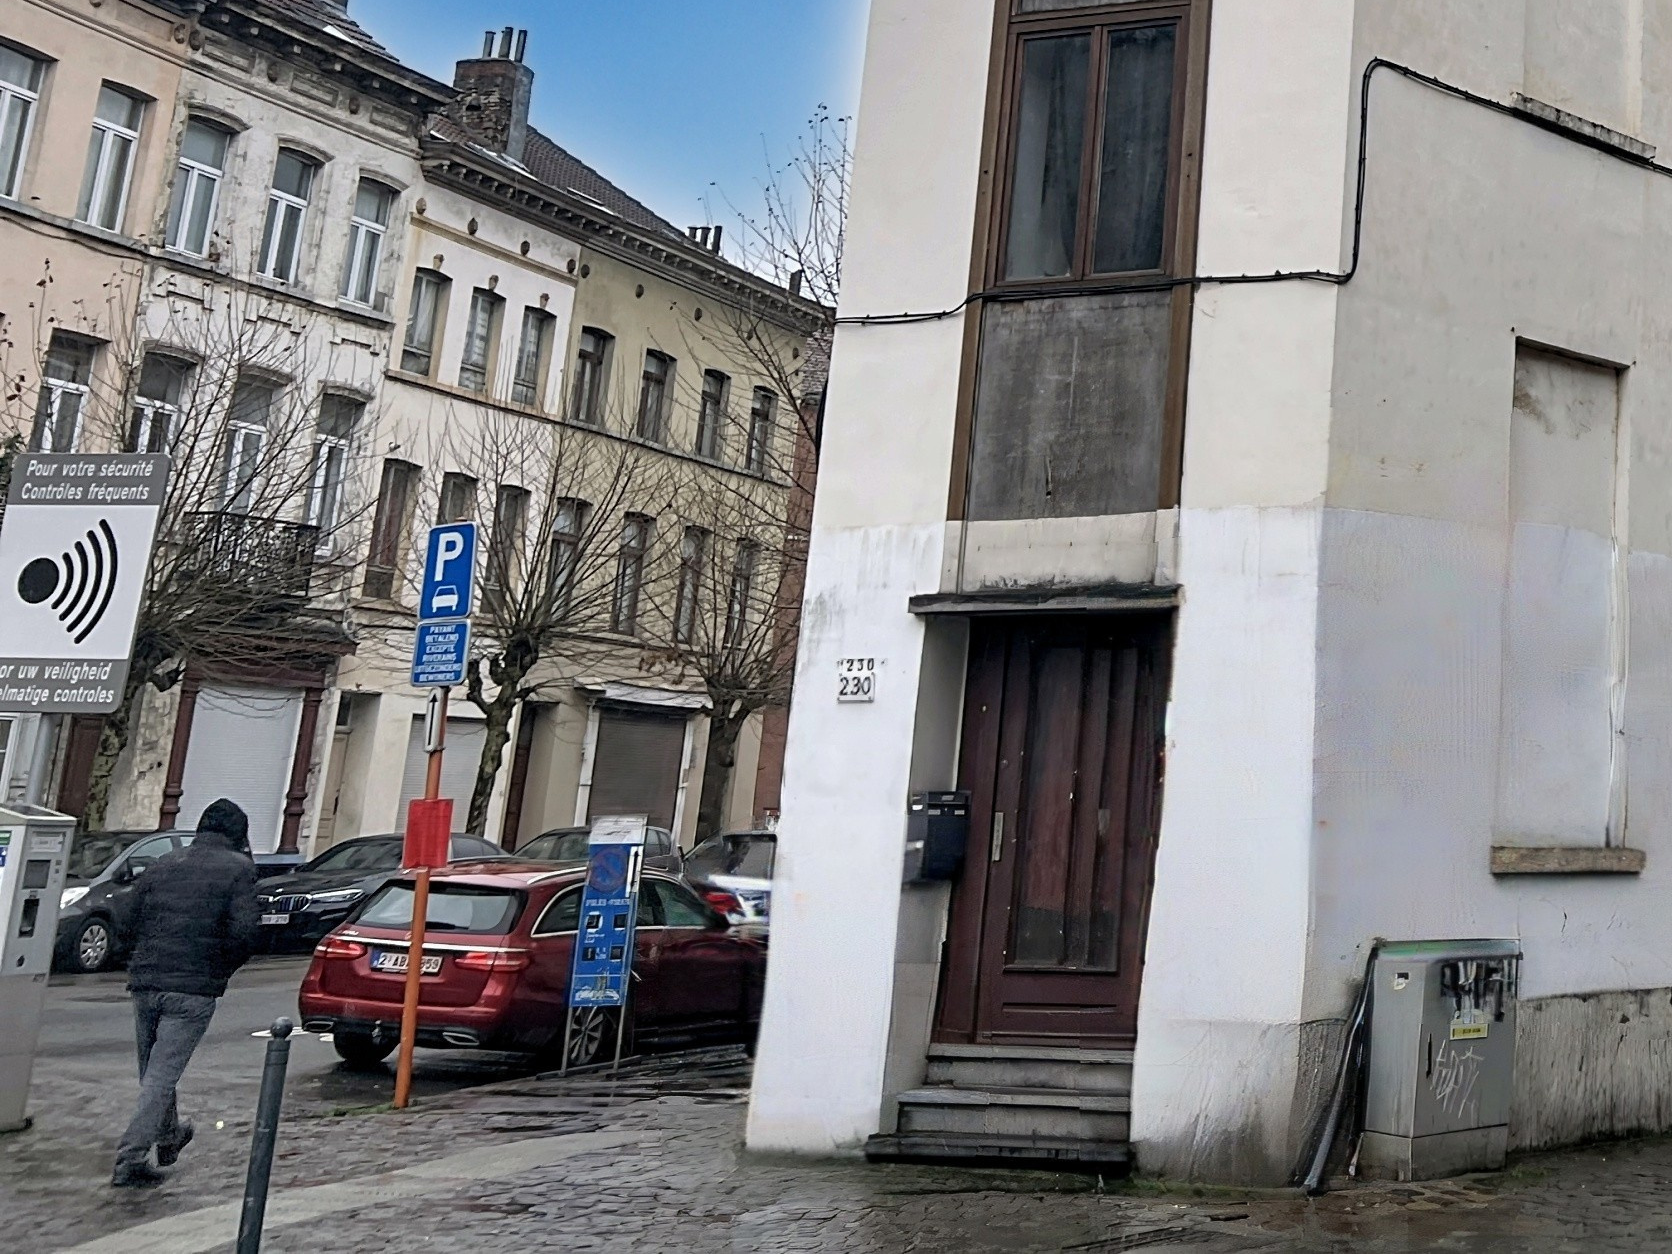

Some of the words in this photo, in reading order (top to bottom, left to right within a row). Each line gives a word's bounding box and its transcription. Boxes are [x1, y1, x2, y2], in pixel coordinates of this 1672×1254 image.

[26, 460, 58, 477] Pour
[62, 461, 95, 477] votre
[100, 460, 154, 477] sécurité
[21, 483, 83, 500] Contrôles
[87, 483, 150, 503] fréquents
[434, 531, 464, 582] P
[18, 665, 39, 679] uw
[44, 662, 113, 684] veiligheid
[846, 657, 875, 672] 230
[53, 685, 115, 703] controles
[838, 676, 871, 696] 230
